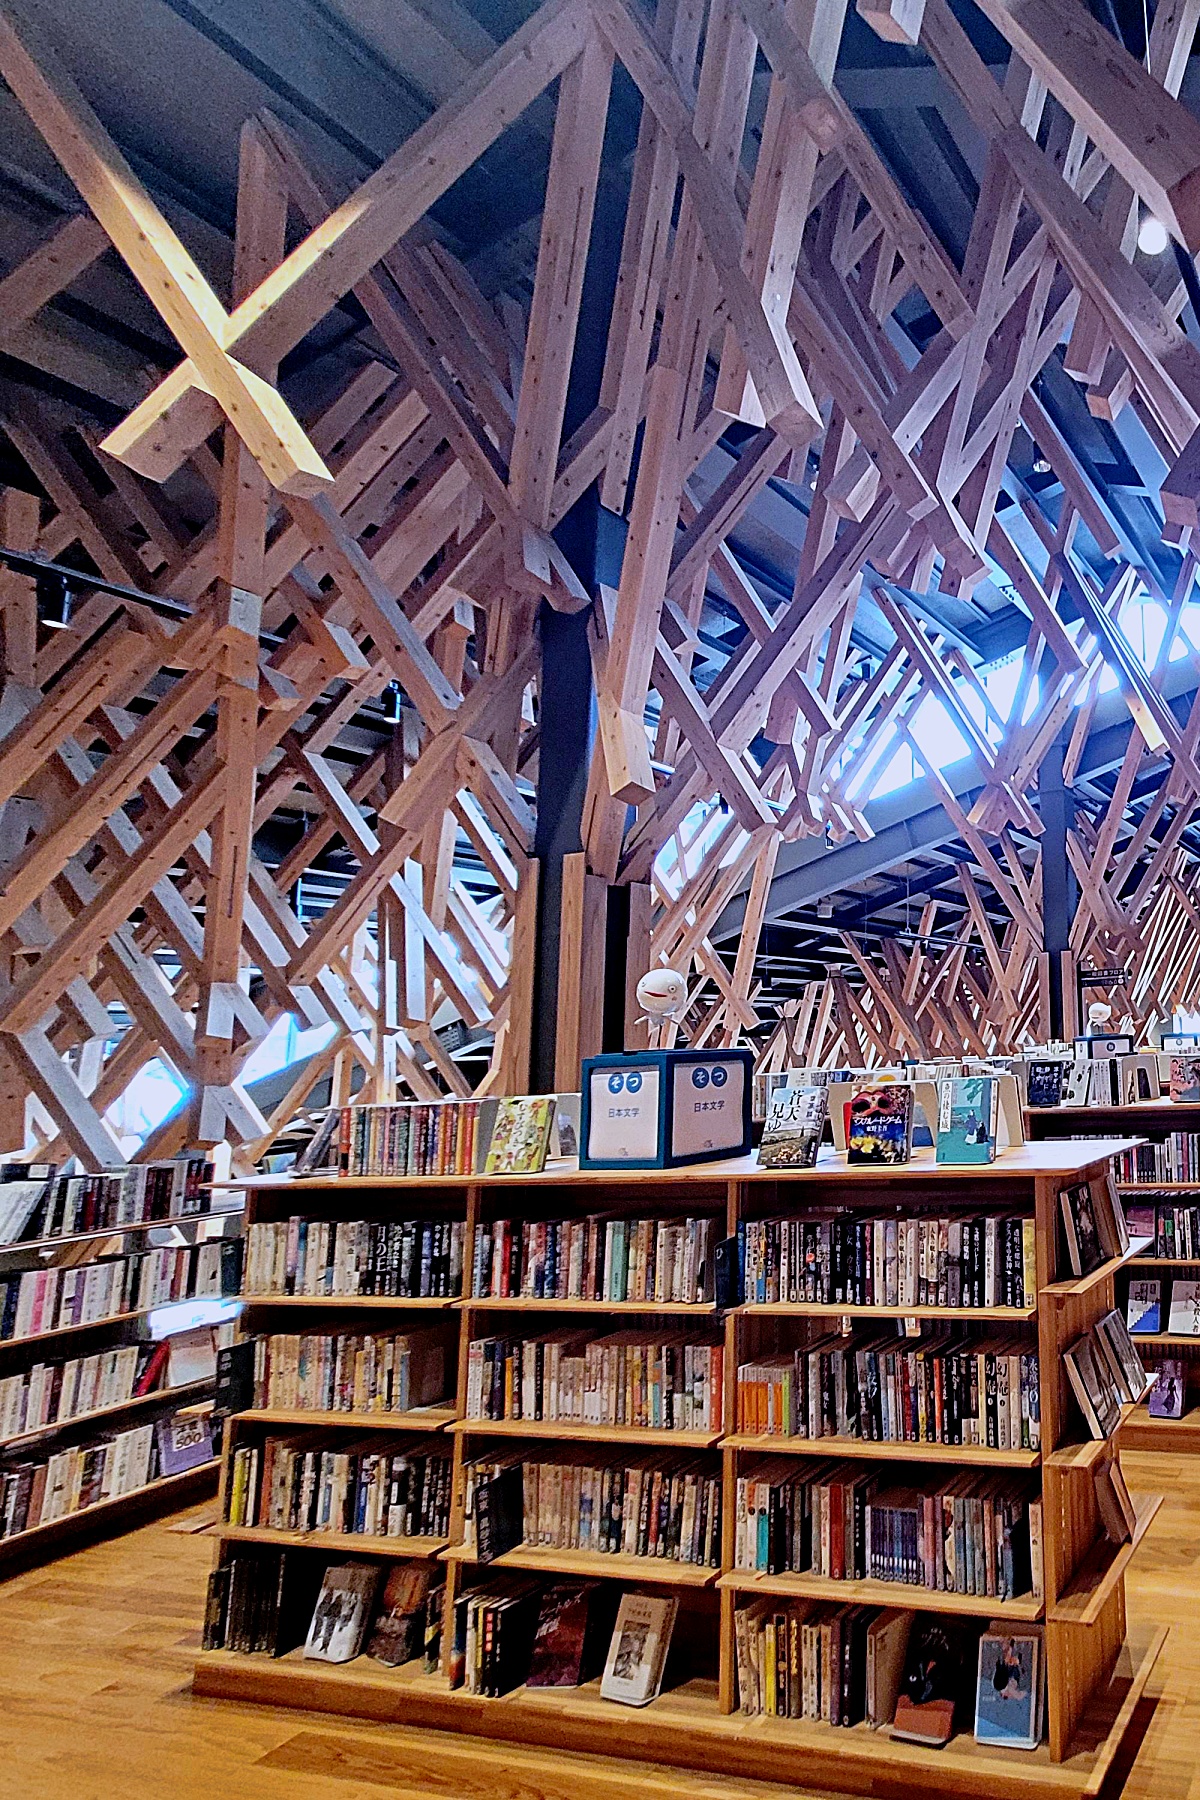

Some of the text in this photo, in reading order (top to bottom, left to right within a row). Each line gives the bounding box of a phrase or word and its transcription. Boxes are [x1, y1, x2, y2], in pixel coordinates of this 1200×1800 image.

[608, 1107, 640, 1118] 日本文学
[693, 1100, 726, 1113] 日本文学
[376, 1225, 387, 1272] 月の王
